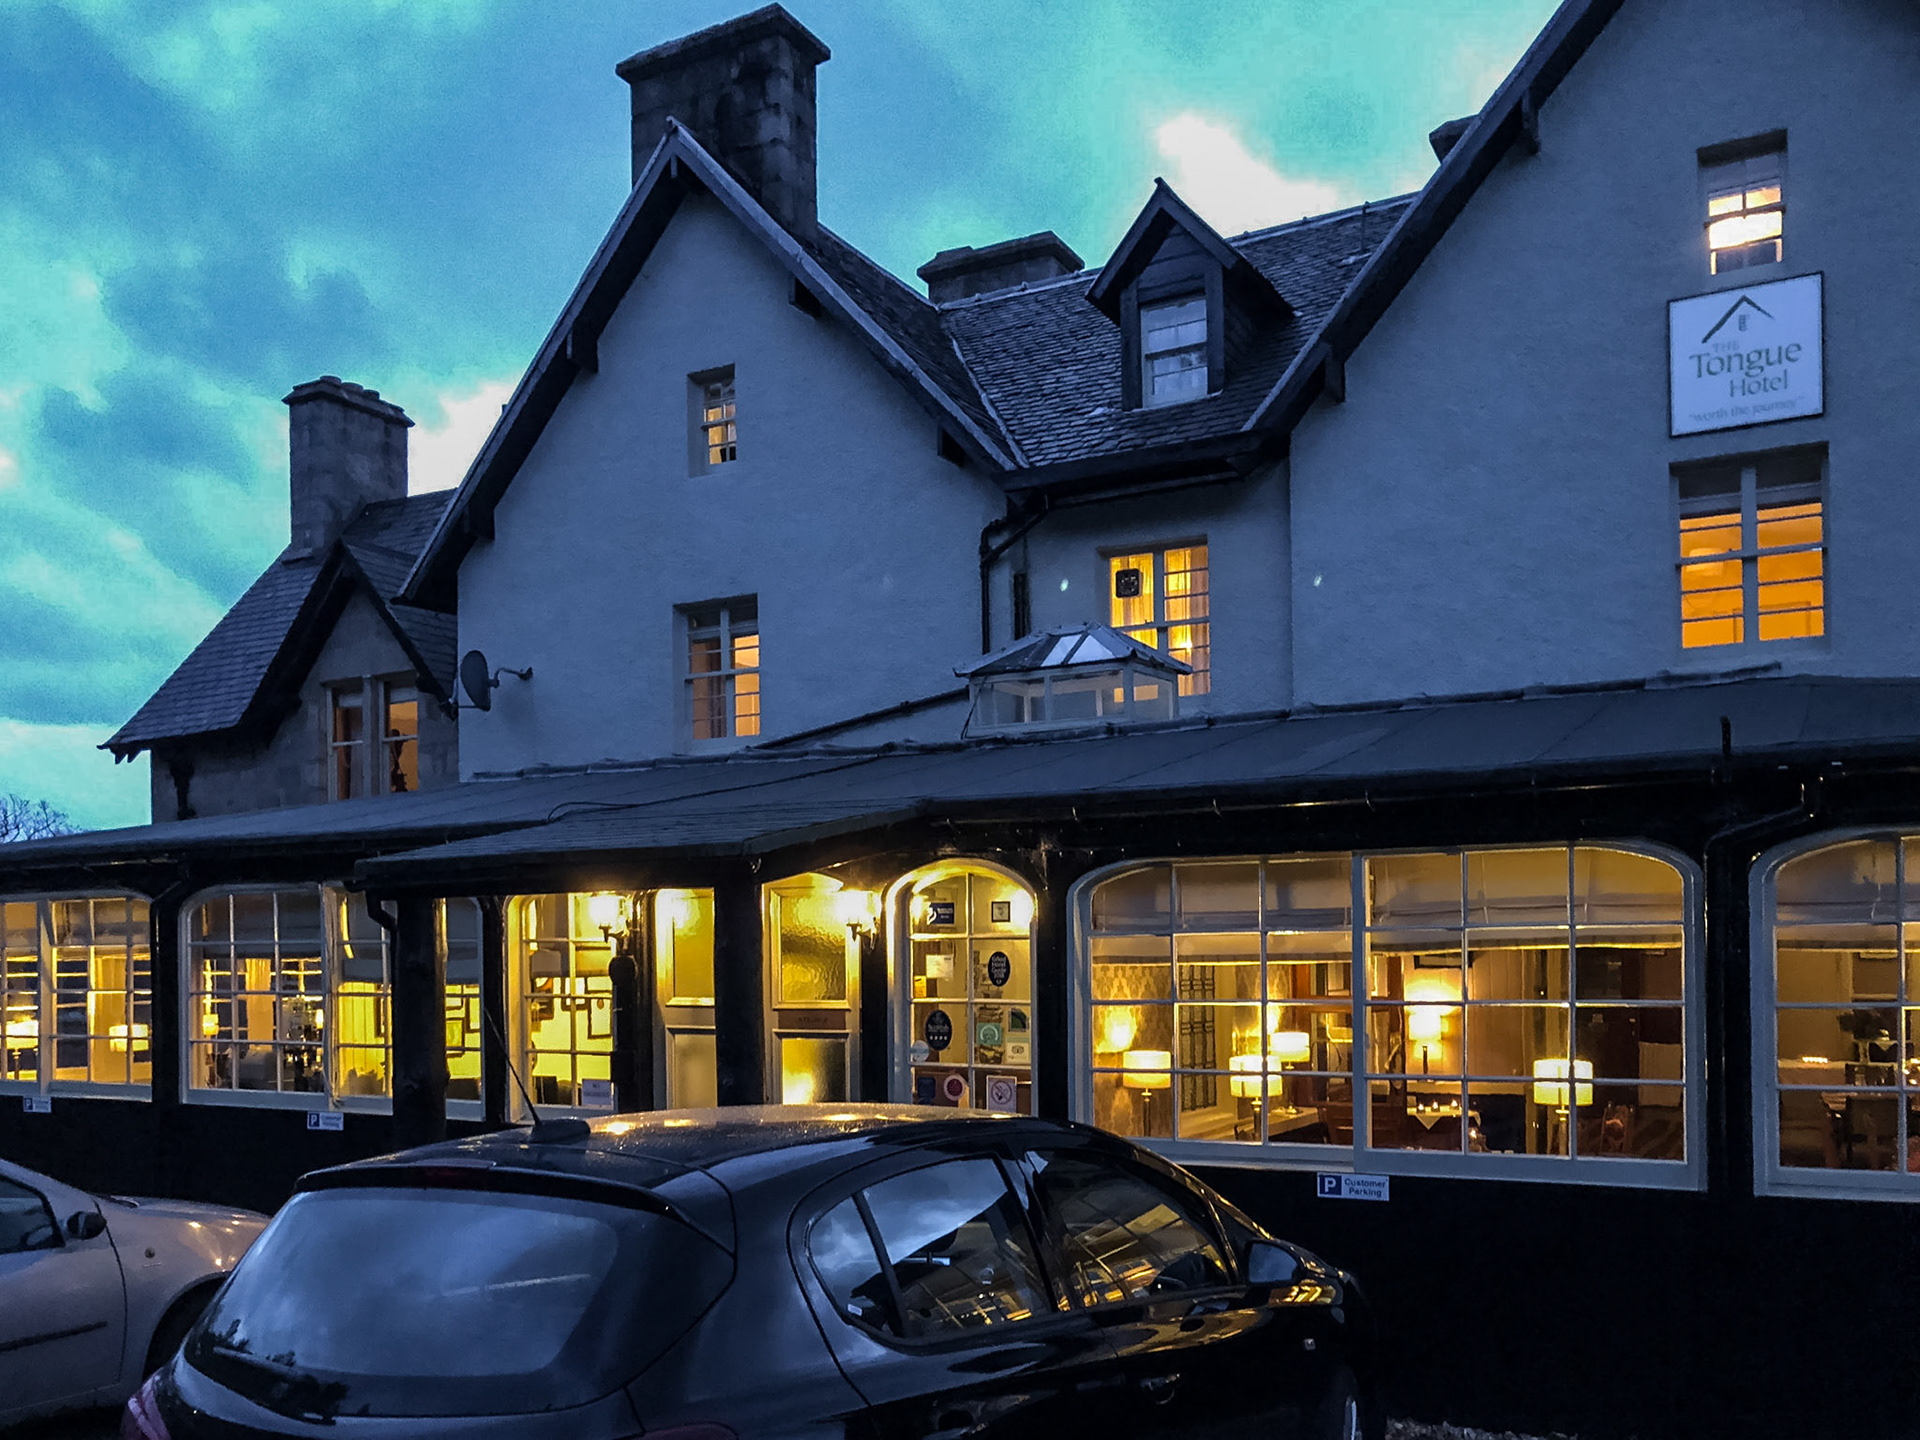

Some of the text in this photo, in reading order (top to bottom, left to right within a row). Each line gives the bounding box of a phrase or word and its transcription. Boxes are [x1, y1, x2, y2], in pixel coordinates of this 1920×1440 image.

[1712, 341, 1740, 352] THE
[1689, 343, 1802, 378] Tongue
[1730, 369, 1788, 397] Hotel
[1324, 1177, 1336, 1192] P
[1344, 1177, 1386, 1188] Customer
[1349, 1187, 1382, 1198] Parking
